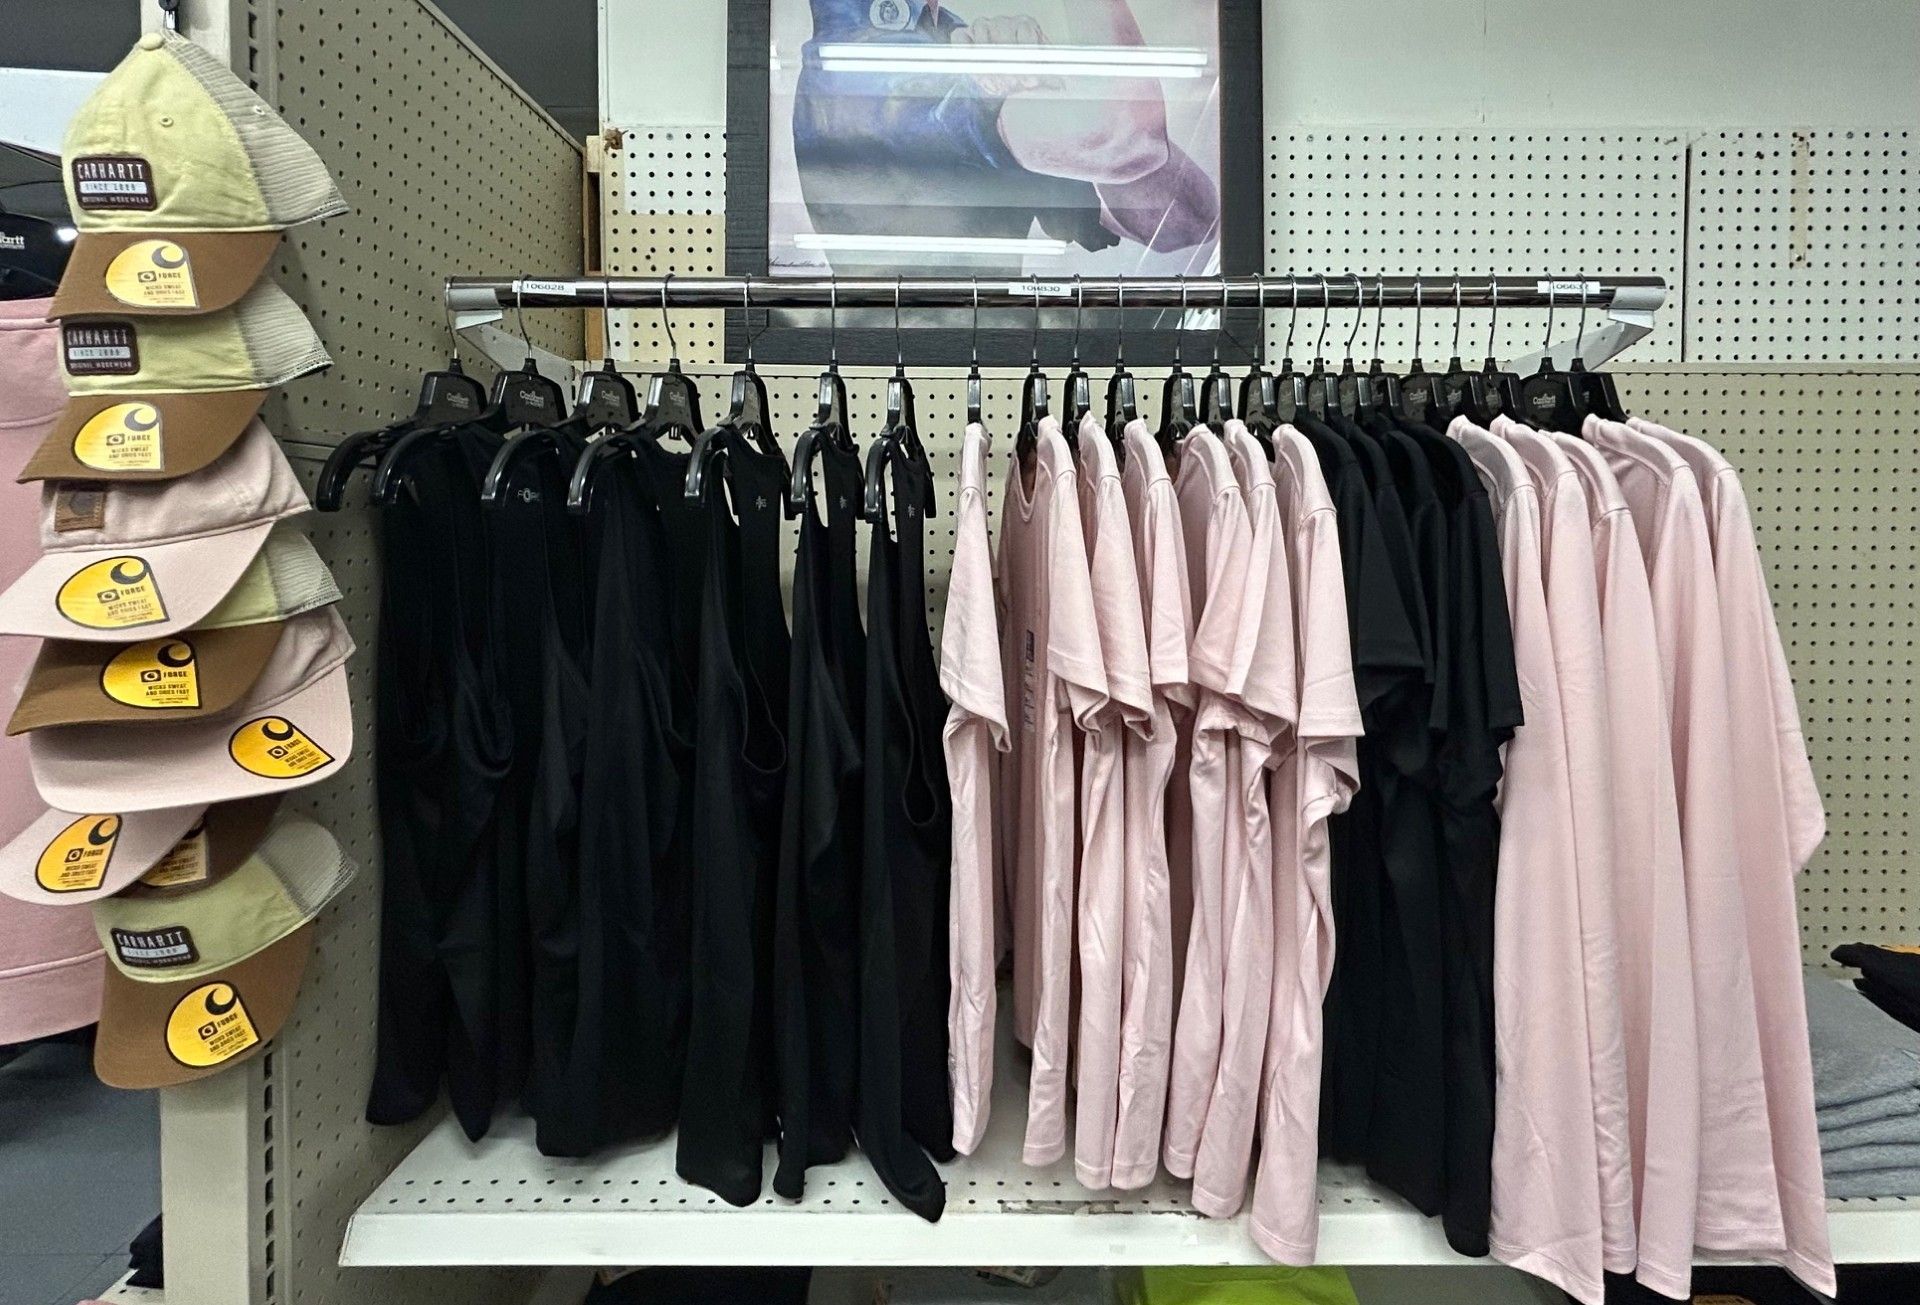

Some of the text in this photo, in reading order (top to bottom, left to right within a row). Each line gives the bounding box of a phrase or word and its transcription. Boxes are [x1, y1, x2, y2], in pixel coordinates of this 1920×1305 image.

[77, 163, 143, 179] CARHARTT
[67, 329, 128, 346] CARHARTT
[121, 585, 145, 595] FORCE
[116, 931, 183, 948] CARHARTT
